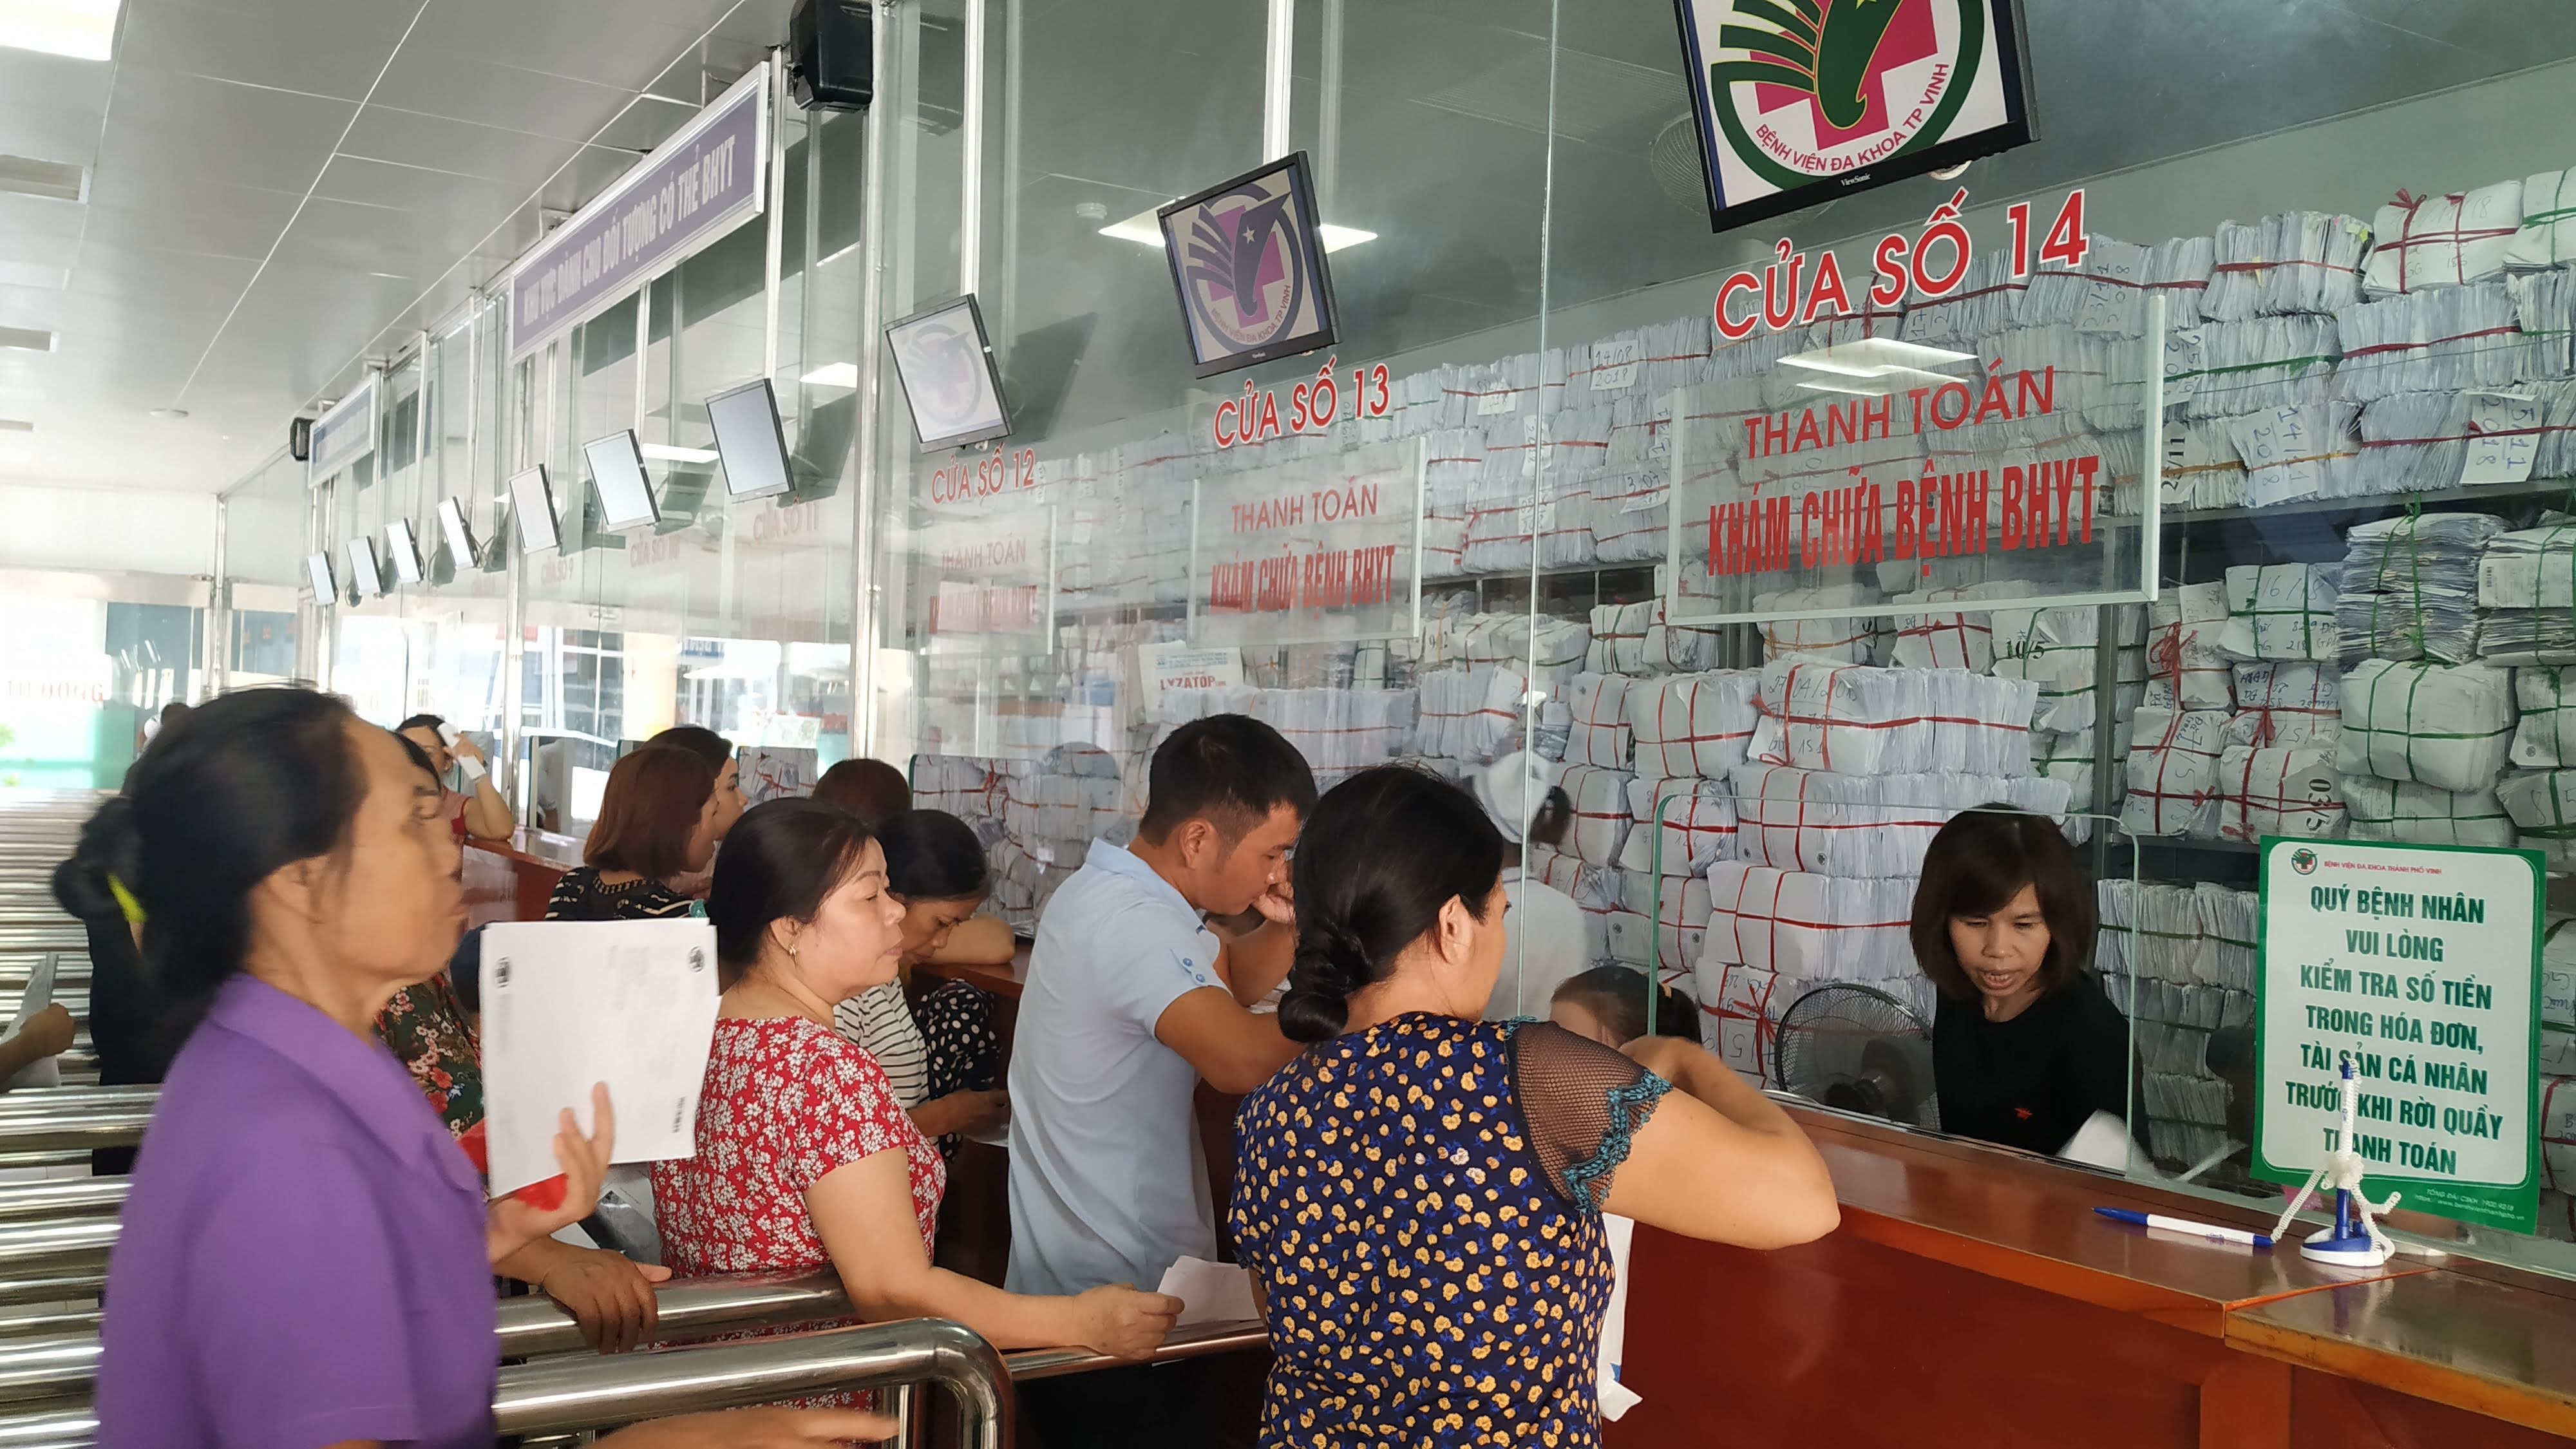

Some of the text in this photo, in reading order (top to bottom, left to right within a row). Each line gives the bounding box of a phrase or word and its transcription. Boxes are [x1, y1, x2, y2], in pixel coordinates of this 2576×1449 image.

[1756, 64, 1949, 173] BỆNH VIỆN ĐA KHOA TP VINH
[623, 194, 657, 262] TƯỢNG
[659, 170, 675, 235] CÓ
[678, 143, 700, 222] THẺ
[702, 134, 735, 205] BHYT
[1841, 173, 1871, 186] ViewSonic
[1714, 237, 1852, 340] CỬA
[1870, 186, 1972, 307] SỐ
[2005, 187, 2090, 279] 14
[1275, 310, 1283, 323] TP
[1280, 285, 1291, 309] VINH
[1214, 379, 1282, 449] CỬA
[1291, 354, 1338, 434] SỐ
[1354, 364, 1390, 420] 13
[1744, 394, 1890, 459] THANH
[1908, 357, 2055, 433] TOÁN
[932, 453, 971, 504] CỬA
[978, 441, 1005, 498] SỐ
[1014, 448, 1036, 489] 12
[1232, 475, 1379, 534] THANH TOÁN
[1709, 484, 1791, 576] KHÁM
[1802, 464, 1884, 570] CHỮA
[1895, 459, 1988, 577] BỆNH
[2000, 455, 2100, 551] BHYT
[942, 533, 1027, 573] THANH TOÁN
[1210, 540, 1396, 621] KHÁM CHỮA BỆNH BHYT
[2311, 883, 2485, 923] QUÝ BỆNH NHÂN
[2345, 928, 2444, 962] VUI LÒNG
[2300, 957, 2492, 1010] KIỂM TRA SỐ TIỀN
[2305, 1005, 2484, 1055] TRONG HÓA ĐƠN,
[2300, 1041, 2488, 1095] TÀI SẢN CÁ NHÂN
[2285, 1080, 2342, 1113] TRƯỚ
[2357, 1093, 2392, 1122] KHI
[2400, 1095, 2436, 1130] RỜI
[2443, 1103, 2504, 1141] QUẦY
[2398, 1141, 2457, 1176] TOÁN
